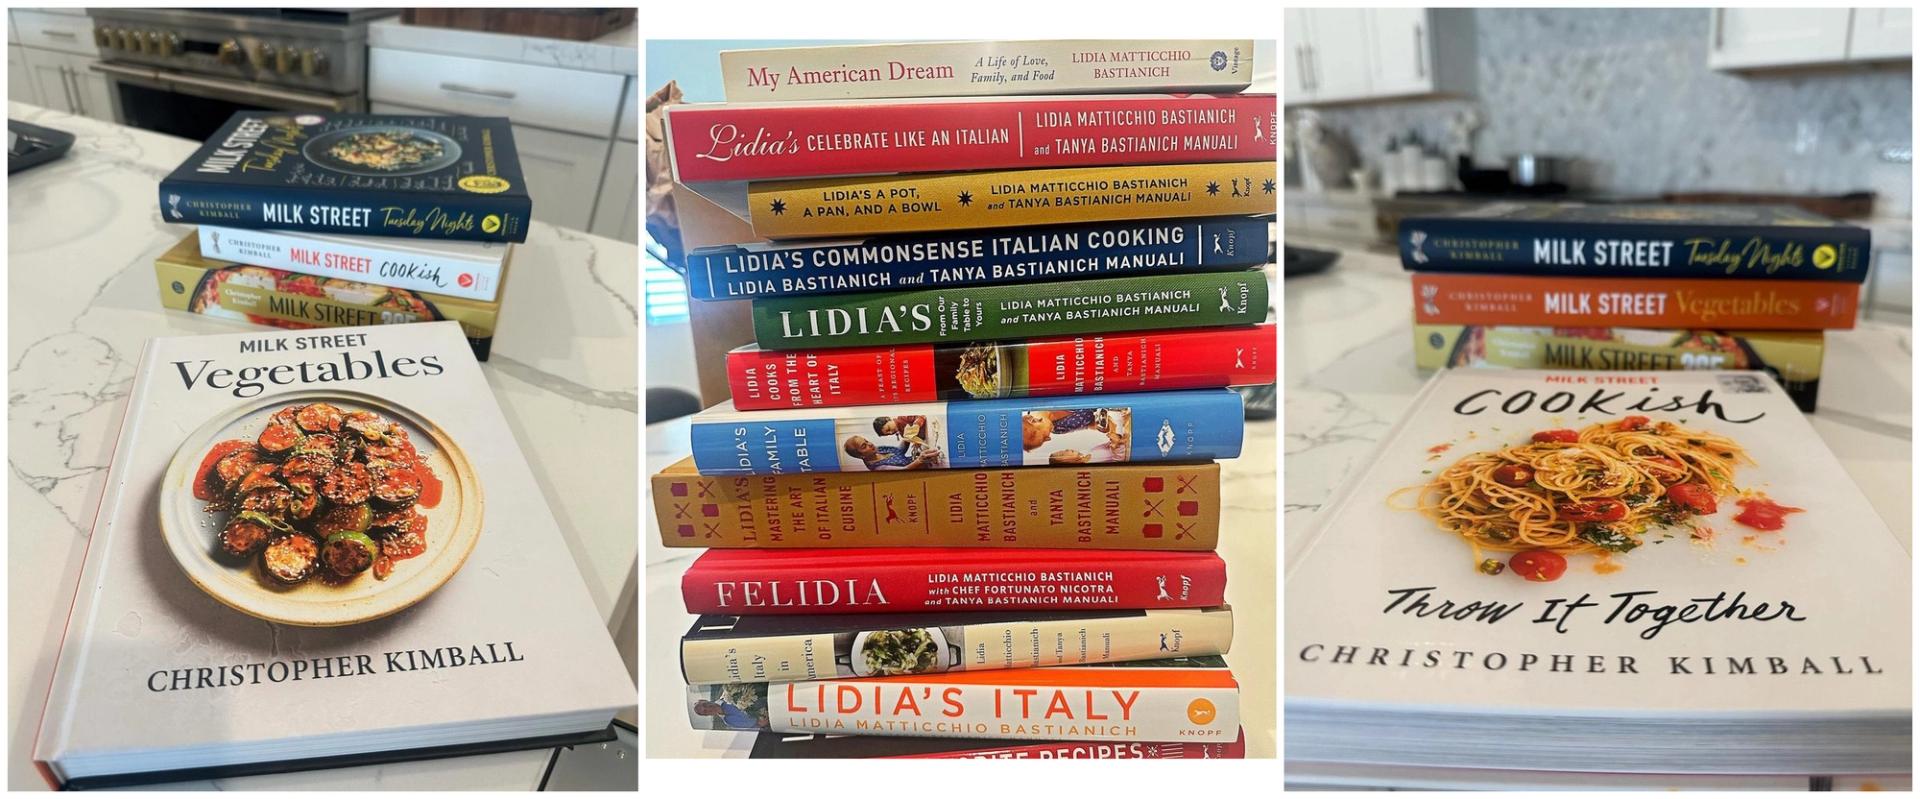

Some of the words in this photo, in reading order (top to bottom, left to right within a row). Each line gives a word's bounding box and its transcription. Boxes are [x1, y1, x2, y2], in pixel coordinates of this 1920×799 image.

[975, 57, 984, 68] A
[987, 56, 1007, 68] Life
[1011, 55, 1020, 68] of
[1022, 55, 1049, 68] Love,
[1072, 51, 1107, 64] LIDIA
[1109, 50, 1191, 63] MATTICCHIO
[1231, 47, 1239, 75] Vintage
[747, 66, 780, 92] My
[787, 64, 881, 86] American
[888, 61, 954, 81] Dream
[971, 70, 1008, 85] Family,
[1011, 70, 1030, 82] and
[1032, 69, 1055, 82] Food
[1094, 66, 1170, 79] BASTIANICH
[1036, 111, 1072, 128] LIDIA
[1077, 109, 1156, 127] MATTICCHIO
[1161, 108, 1236, 125] BASTIANICH
[696, 123, 800, 162] Lidia's
[807, 132, 889, 151] CELEBRATE
[894, 130, 926, 148] LIKE
[931, 129, 951, 146] AN
[956, 128, 1009, 145] ITALIAN
[1034, 143, 1050, 156] and
[1055, 137, 1096, 155] TANYA
[1101, 135, 1178, 153] BASTIANICH
[1183, 134, 1239, 151] MANUALI
[823, 189, 871, 202] LIDIA'S
[876, 189, 886, 200] A
[890, 187, 920, 200] POT,
[991, 183, 1026, 195] LIDIA
[1030, 180, 1109, 194] MATTICCHIO
[1113, 178, 1188, 191] BASTIANICH
[186, 200, 252, 211] CHRISTOPHER
[803, 207, 813, 217] A
[817, 205, 849, 218] PAN,
[854, 204, 882, 215] AND
[887, 203, 898, 214] A
[902, 202, 942, 213] BOWL
[987, 201, 1005, 210] and
[1008, 197, 1051, 209] TANYA
[1055, 194, 1131, 207] BASTIANICH
[1135, 191, 1191, 204] MANUALI
[199, 210, 240, 219] KIMBALL
[263, 202, 304, 224] MILK
[310, 205, 372, 228] STREET
[380, 206, 426, 234] Tuesday
[425, 207, 474, 235] Nights
[228, 238, 281, 253] CHRISTOPHER
[239, 248, 272, 259] KIMBALL
[725, 251, 805, 274] LIDIA'S
[812, 239, 984, 268] COMMONSENSE
[992, 234, 1079, 257] ITALIAN
[1087, 226, 1184, 249] COOKING
[1533, 238, 1586, 265] MILK
[1594, 240, 1674, 267] STREET
[1683, 237, 1743, 275] Tuesday
[290, 247, 321, 266] MILK
[325, 253, 372, 274] STREET
[728, 279, 776, 296] LIDIA
[782, 272, 891, 293] BASTIANICH
[899, 272, 924, 285] and
[930, 268, 986, 283] TANYA
[992, 257, 1098, 279] BASTIANICH
[1105, 252, 1184, 270] MANUALI
[269, 296, 310, 320] MILK
[315, 303, 377, 326] STREET
[963, 297, 970, 307] to
[1000, 299, 1033, 311] LIDIA
[1037, 295, 1112, 308] MATTICCHIO
[1116, 290, 1191, 303] BASTIANICH
[1237, 281, 1249, 314] Knopf
[1544, 292, 1591, 315] MILK
[1598, 293, 1667, 316] STREET
[1675, 290, 1801, 322] Vegetables
[779, 302, 932, 338] LIDIA'S
[950, 302, 958, 330] Family
[963, 308, 971, 332] Table
[975, 302, 983, 327] Yours
[1000, 315, 1018, 325] and
[1022, 312, 1061, 323] TANYA
[1066, 307, 1140, 320] BASTIANICH
[1144, 303, 1200, 315] MANUALI
[240, 336, 289, 354] MILK
[295, 333, 368, 352] STREET
[1545, 343, 1593, 370] MILK
[1599, 349, 1675, 371] STREET
[786, 353, 797, 374] THE
[806, 353, 818, 367] OF
[1056, 354, 1065, 380] LIDIA
[1075, 337, 1084, 393] MATTICCHIO
[1094, 337, 1104, 391] BASTIANICH
[171, 350, 445, 399] Vegetables
[745, 367, 760, 398] LIDIA
[765, 362, 781, 400] COOKS
[827, 364, 841, 395] ITALY
[1545, 375, 1587, 384] MILK
[1595, 375, 1660, 385] STREET
[790, 380, 803, 406] FROM
[808, 372, 823, 405] HEART
[794, 427, 812, 472] TABLE
[957, 432, 966, 459] LIDIA
[735, 477, 757, 541] LIDIA'S
[763, 477, 784, 542] MASTERING
[789, 486, 803, 508] ART
[813, 478, 829, 522] ITALIAN
[840, 485, 855, 532] CUISINE
[907, 493, 918, 523] KNOPF
[949, 492, 963, 523] LIDIA
[975, 472, 991, 541] MATTICCHIO
[1001, 472, 1017, 542] BASTIANICH
[1028, 499, 1038, 517] and
[1050, 489, 1064, 526] TANYA
[1077, 471, 1092, 543] BASTIANICH
[1105, 480, 1120, 535] MANUALI
[792, 512, 805, 533] THE
[818, 527, 832, 540] OF
[928, 573, 959, 583] LIDIA
[963, 572, 1036, 583] MATTICCHIO
[1040, 571, 1113, 582] BASTIANICH
[928, 586, 949, 595] with
[952, 586, 980, 595] CHEF
[984, 584, 1056, 595] FORTUNATO
[1060, 584, 1114, 594] NICOTRA
[1180, 575, 1191, 600] Knopf
[713, 577, 891, 608] FELIDIA
[924, 598, 942, 606] and
[945, 597, 983, 605] TANYA
[987, 596, 1059, 605] BASTIANICH
[1062, 595, 1119, 604] MANUALI
[1382, 587, 1524, 625] Throw
[1532, 593, 1599, 634] It
[1603, 591, 1807, 640] Together
[147, 653, 377, 693] CHRISTOPHER
[384, 641, 525, 673] KIMBALL
[752, 655, 766, 678] Italy
[778, 660, 789, 671] in
[976, 643, 985, 664] Lidia
[1299, 643, 1640, 674] CHRISTOPHER
[1669, 655, 1884, 675] KIMBALL
[787, 682, 965, 718] LIDIA'S
[994, 687, 1140, 721] ITALY
[790, 717, 845, 730] LIDIA
[856, 719, 988, 734] MATTICCHIO
[1000, 723, 1137, 737] BASTIANICH
